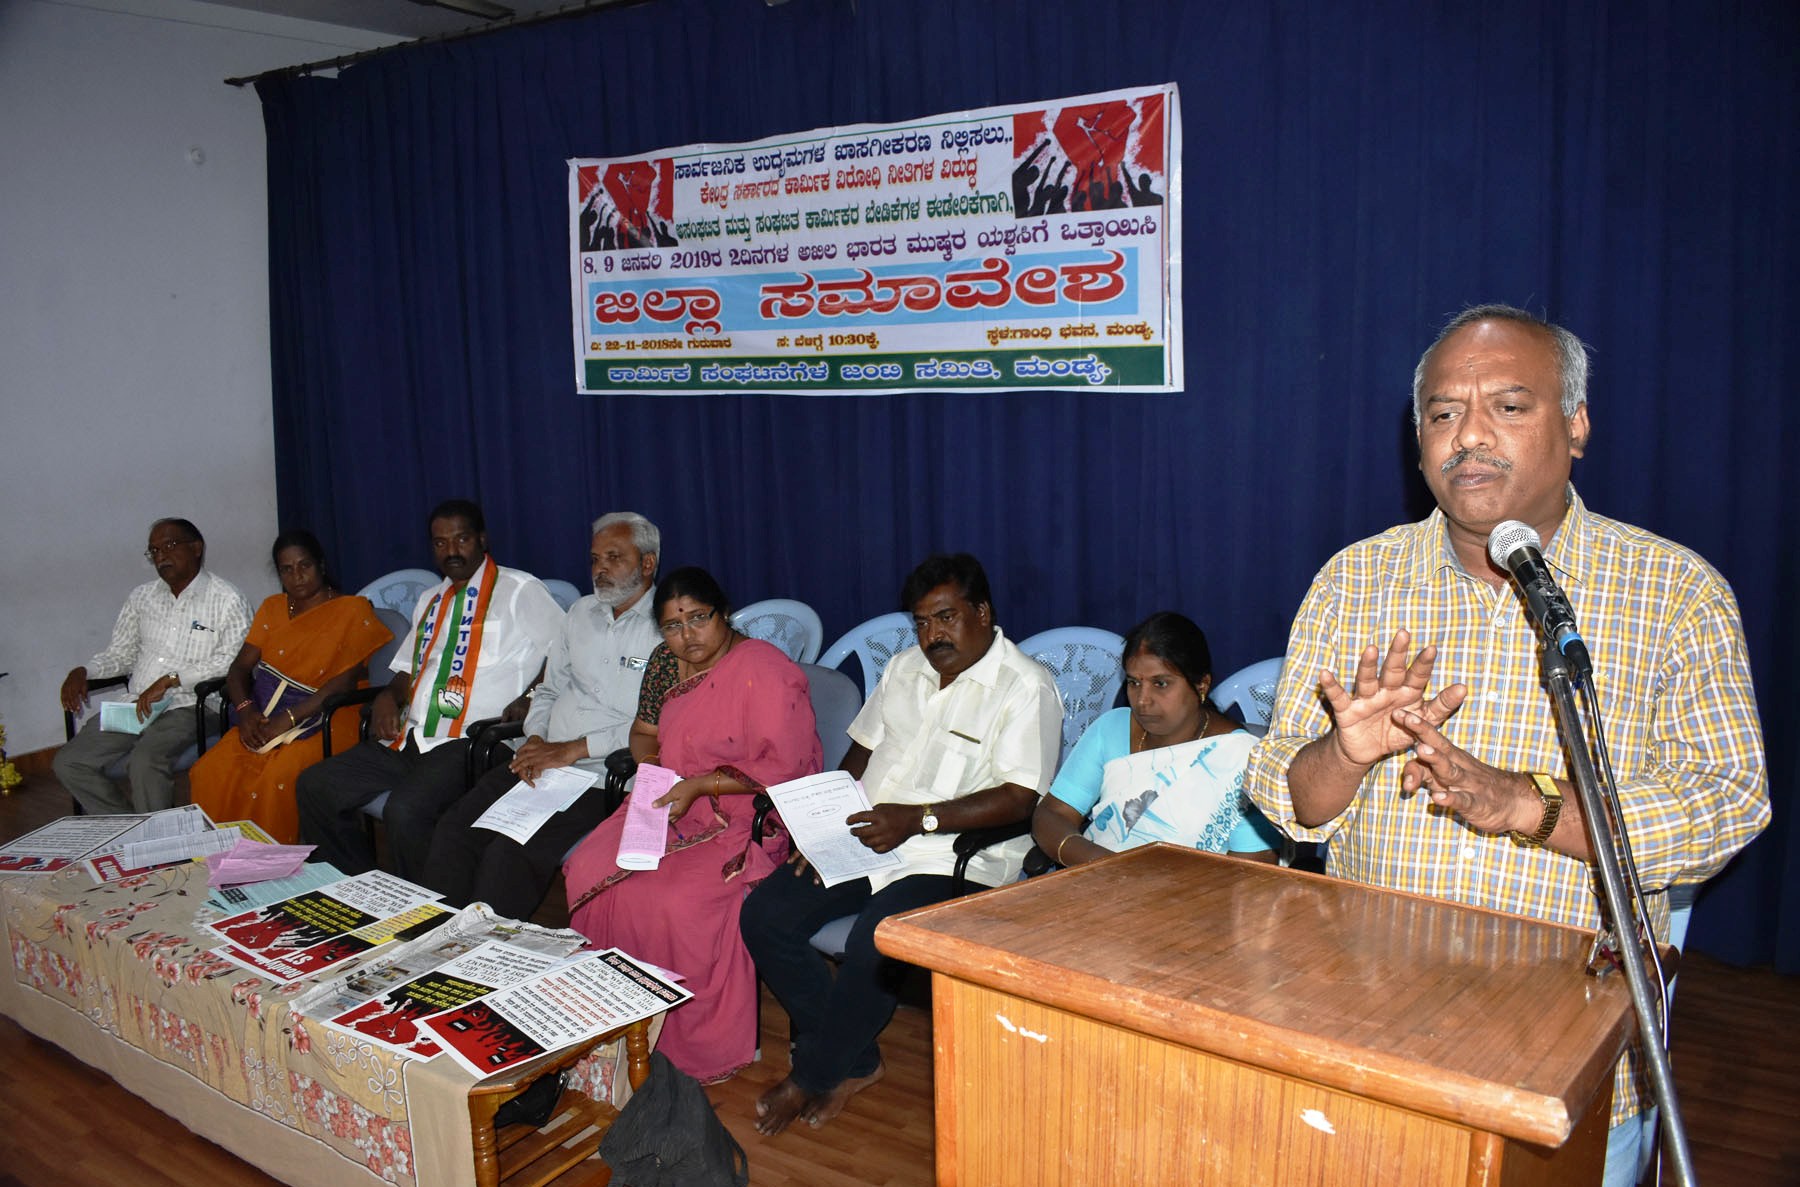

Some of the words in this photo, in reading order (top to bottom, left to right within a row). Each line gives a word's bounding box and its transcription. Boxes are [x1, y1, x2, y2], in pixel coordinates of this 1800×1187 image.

[674, 152, 746, 180] ಸಾರ್ವಜನಿಕ
[753, 142, 826, 178] ಉದ್ಯಮಗಳ
[834, 132, 932, 160] ಖಾಸಗೀಕರಣ
[700, 181, 730, 209] ಕೇಂದ್ರ
[734, 175, 780, 200] ಸರ್ಕಾರದ
[785, 168, 830, 195] ಕಾರ್ಮಿಕ
[836, 164, 882, 190] ವಿರೋಧಿ
[888, 156, 934, 185] ನೀತಿಗಳ
[941, 152, 978, 190] ವಿರುದ್ಧ
[676, 214, 720, 242] ಅಸಂಘಟಿತ
[725, 212, 752, 242] ಮತ್ತು
[756, 207, 800, 235] ಸಂಘಟಿತ
[805, 201, 860, 229] ಕಾರ್ಮಿಕರ
[866, 196, 920, 223] ಬೇಡಿಕೆಗಳ
[584, 257, 597, 274] 8,
[604, 256, 614, 272] 9
[622, 252, 662, 272] ಜನವರಿ
[670, 248, 722, 269] 2019ರ
[729, 240, 789, 266] 2ದಿನಗಳ
[798, 242, 837, 262] ಅಖಿಲ
[846, 233, 896, 261] ಭಾರತ
[906, 228, 966, 261] ಮುಷ್ಕರ
[1060, 216, 1156, 246] ಒತ್ತಾಯಿಸಿ
[594, 288, 722, 336] ಜಿಲ್ಲಾ
[760, 250, 1125, 318] ಸಮಾವೇಶ
[688, 337, 732, 350] ಗುರುವಾರ
[608, 363, 691, 382] ಕಾರ್ಮಿಕ
[841, 363, 902, 380] ಜಂಟಿ
